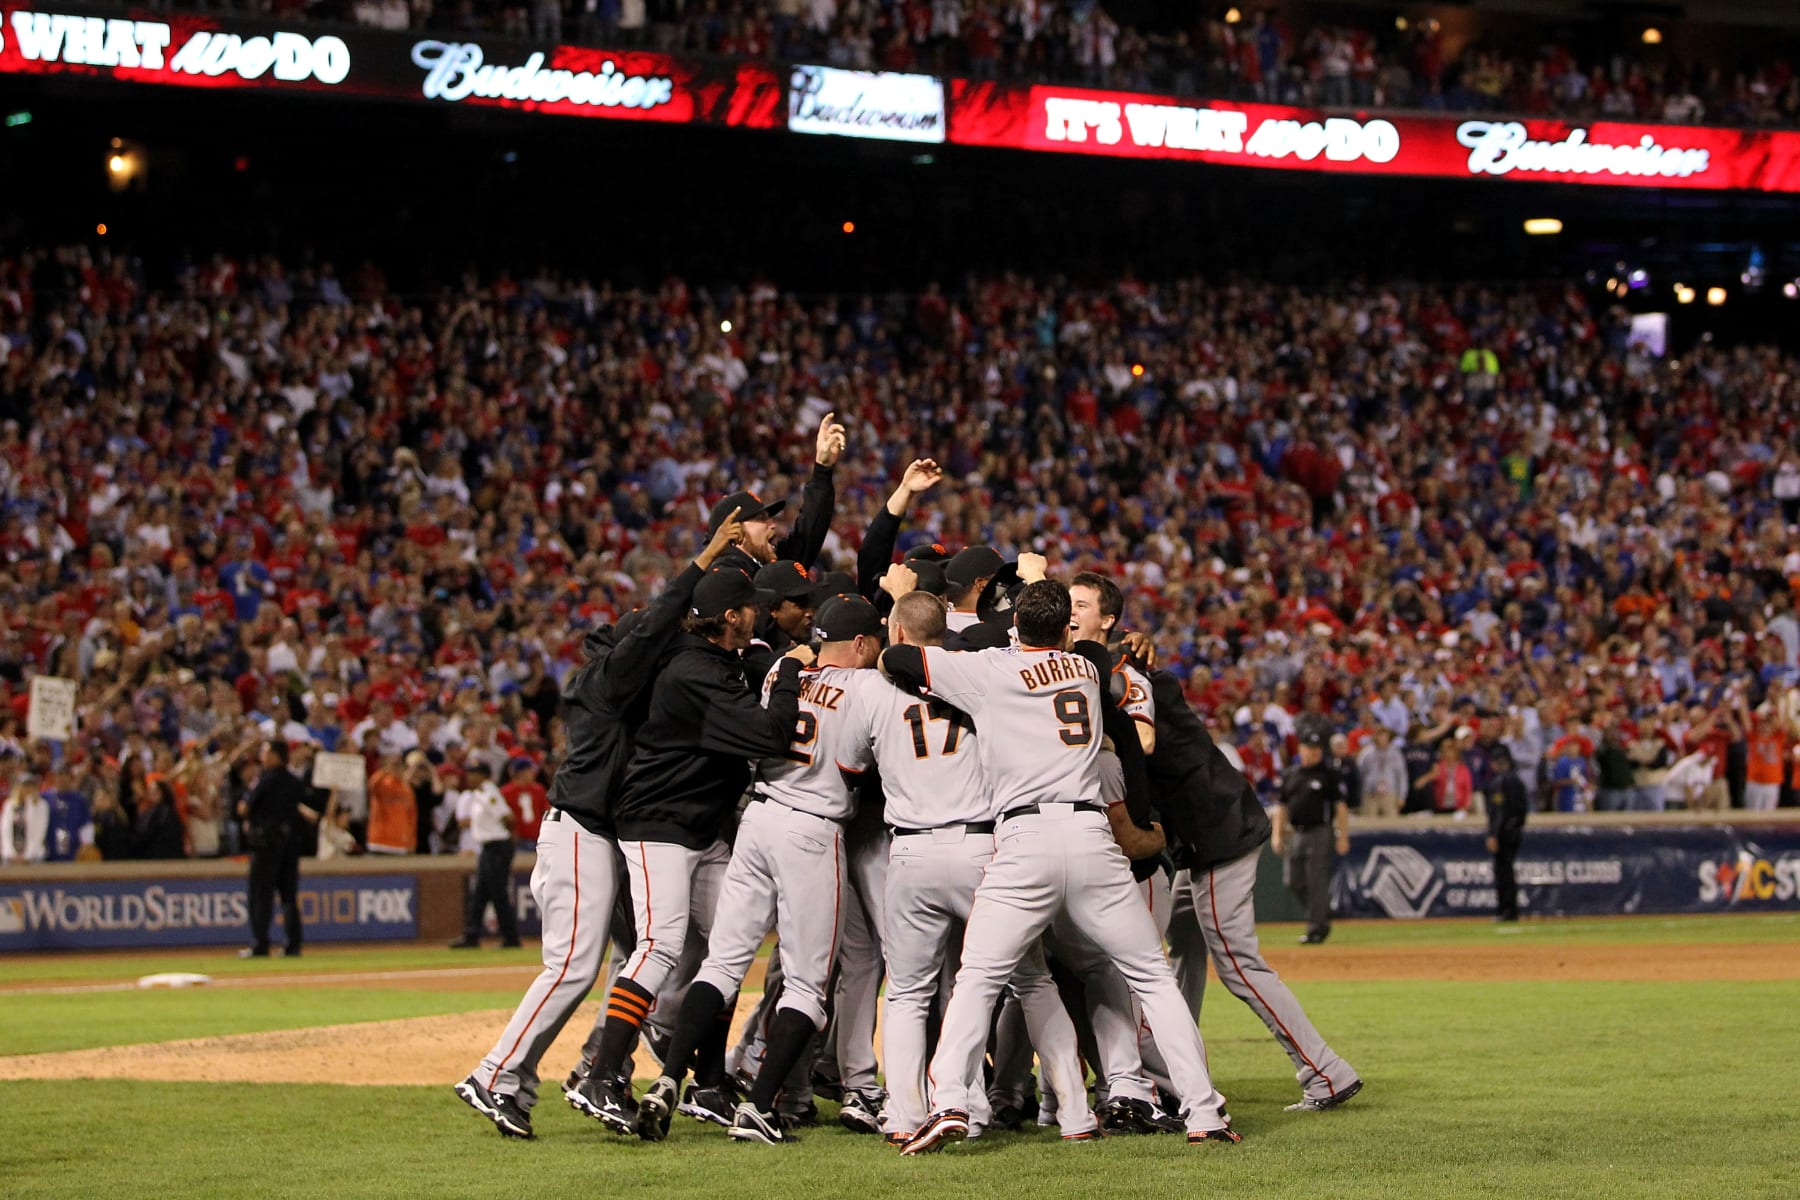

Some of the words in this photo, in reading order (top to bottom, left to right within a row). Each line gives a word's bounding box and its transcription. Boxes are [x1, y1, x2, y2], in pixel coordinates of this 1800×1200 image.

[11, 10, 170, 70] WHAT
[411, 40, 673, 109] Budweiser
[1125, 103, 1247, 153] WHAT
[1456, 121, 1710, 177] Budweiser
[903, 702, 963, 760] 17
[1053, 689, 1093, 749] 9
[357, 888, 413, 924] FOX
